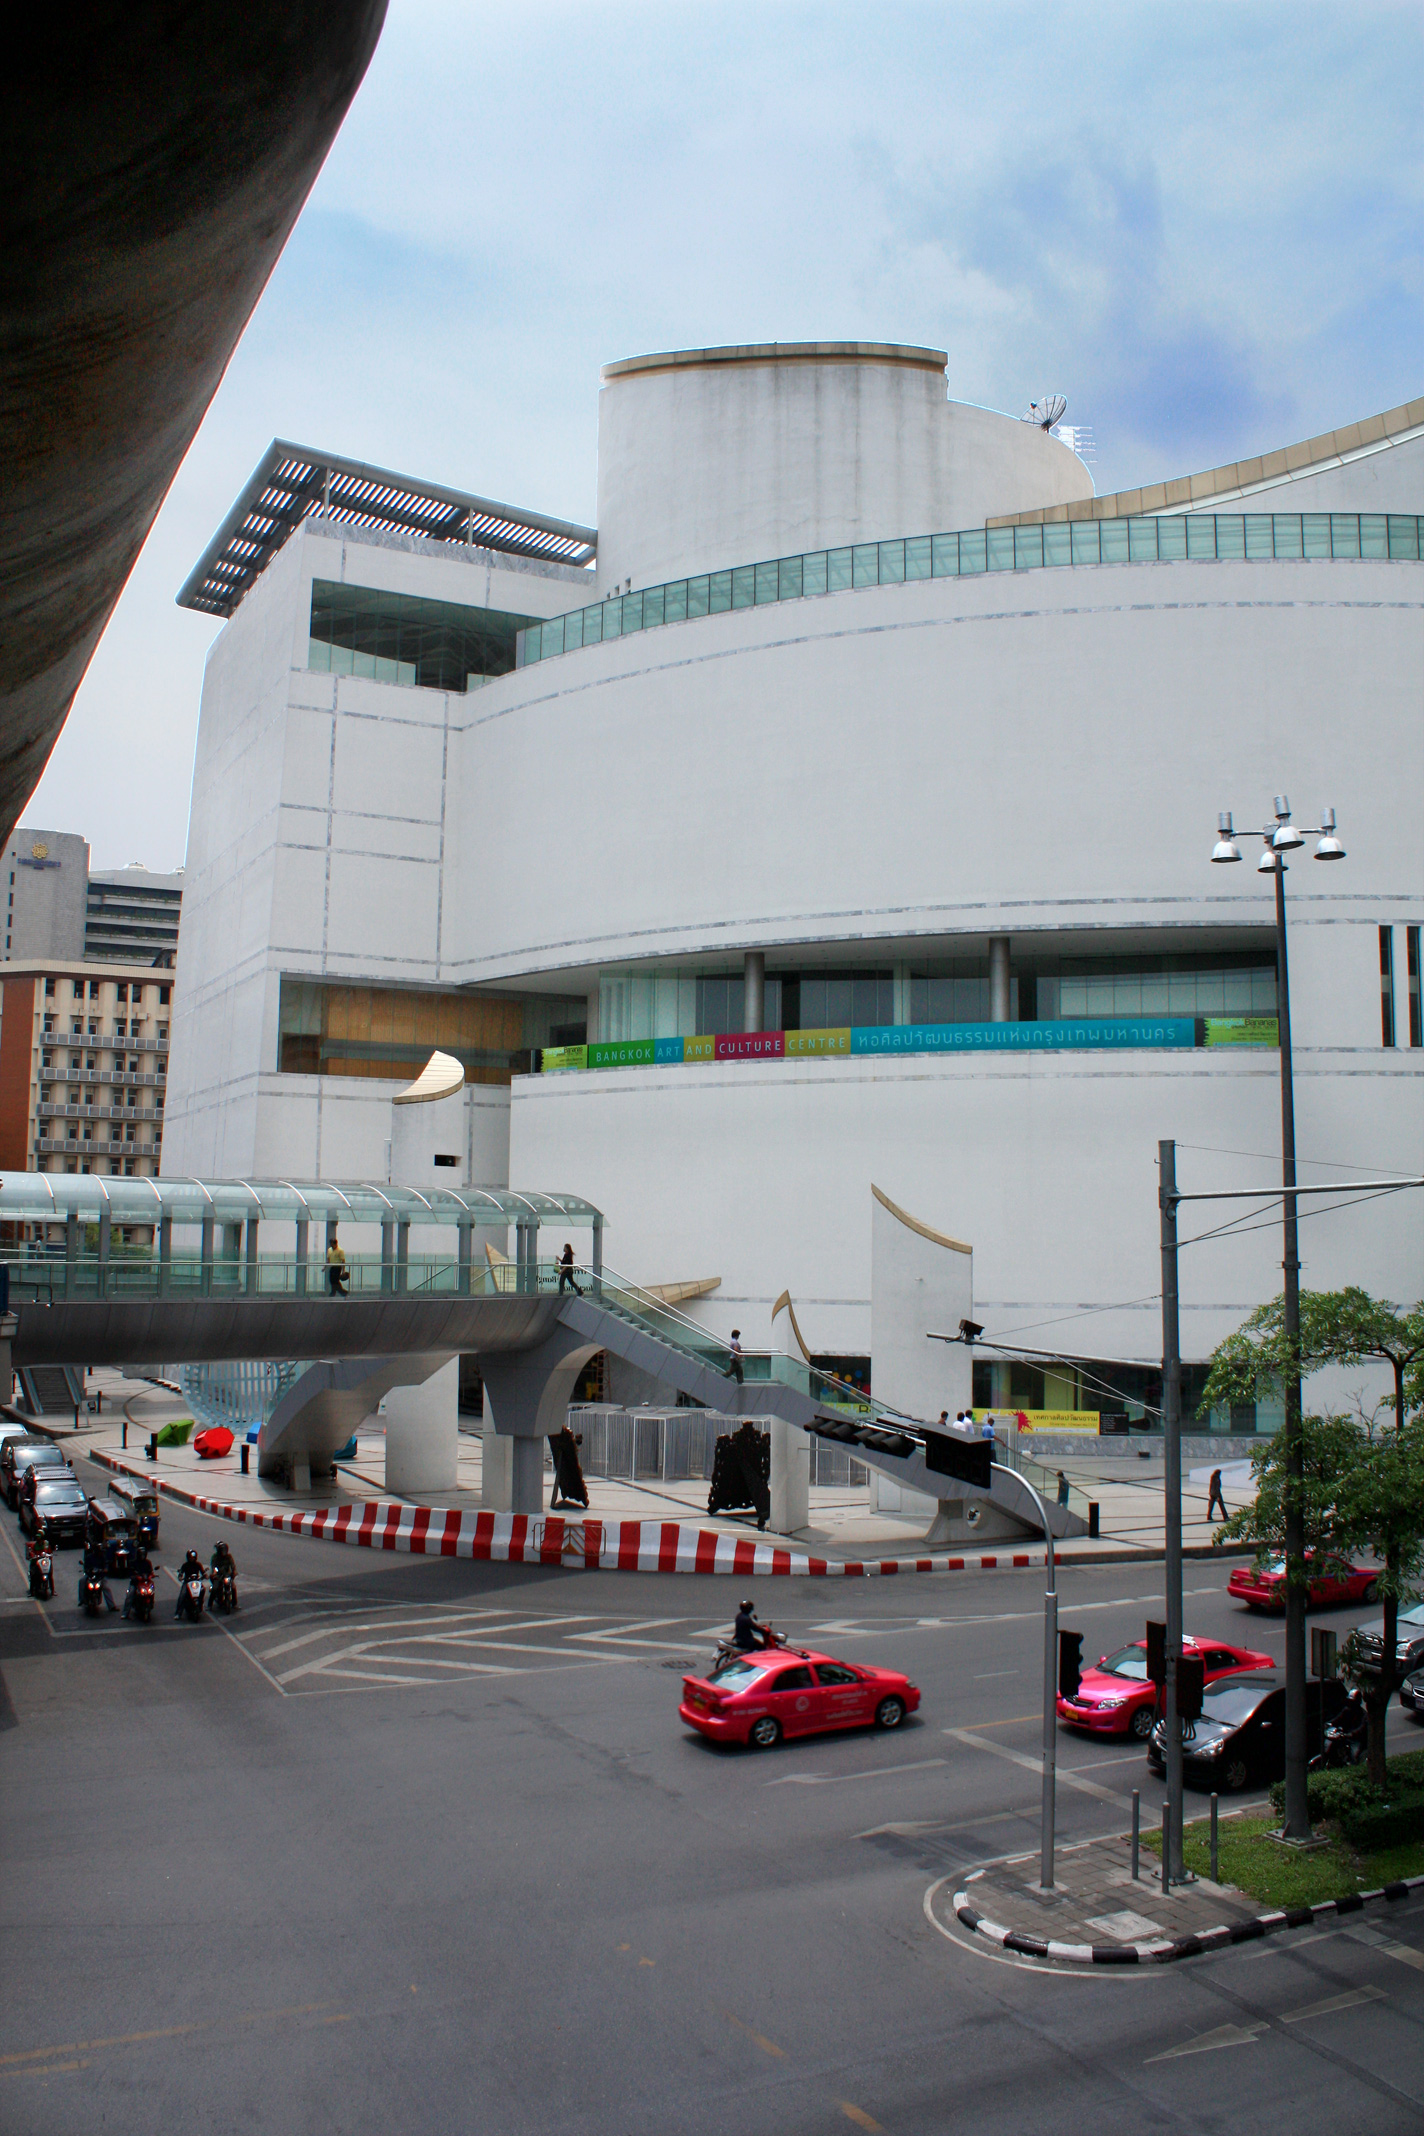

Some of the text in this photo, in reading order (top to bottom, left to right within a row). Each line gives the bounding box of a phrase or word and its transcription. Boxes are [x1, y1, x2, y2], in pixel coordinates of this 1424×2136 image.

[858, 1027, 1176, 1047] หอศิลปวัฒนธรรมแห่งกรุงเทพมหานคร
[596, 1046, 652, 1062] BANGKOK
[657, 1045, 681, 1058] ART
[686, 1043, 713, 1056] AND
[719, 1039, 782, 1054] CULTURE
[788, 1037, 846, 1051] CENTRE
